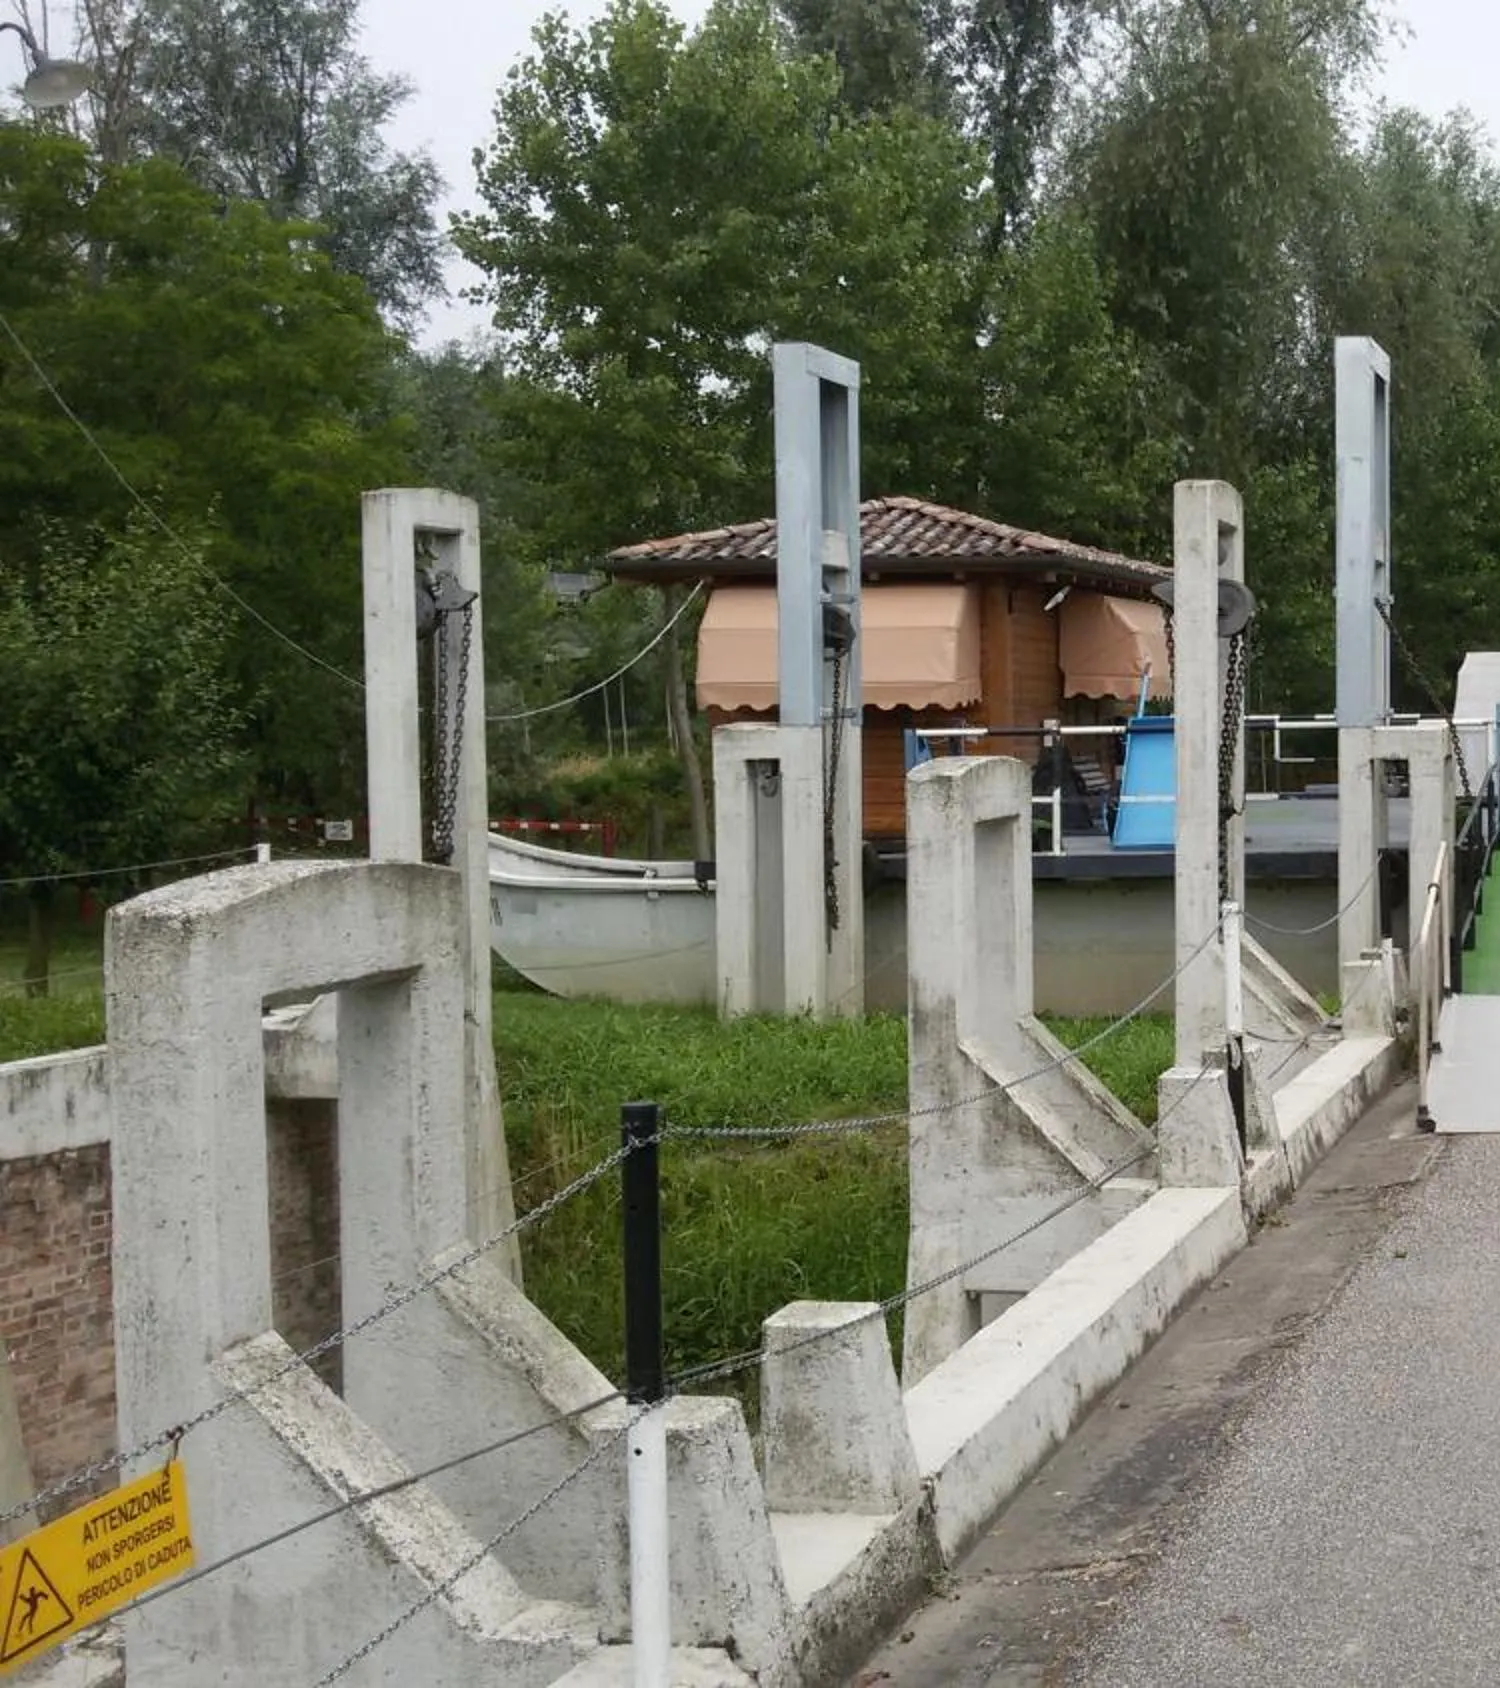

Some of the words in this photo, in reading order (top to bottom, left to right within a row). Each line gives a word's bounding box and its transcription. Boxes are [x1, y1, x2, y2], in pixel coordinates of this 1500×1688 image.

[83, 1480, 172, 1544] ATTENZIONE
[78, 1567, 132, 1610] PERICOLO
[134, 1559, 146, 1578] DI
[147, 1536, 192, 1570] CADUTA
[87, 1547, 111, 1575] NON
[112, 1514, 175, 1558] SPORGERSI
